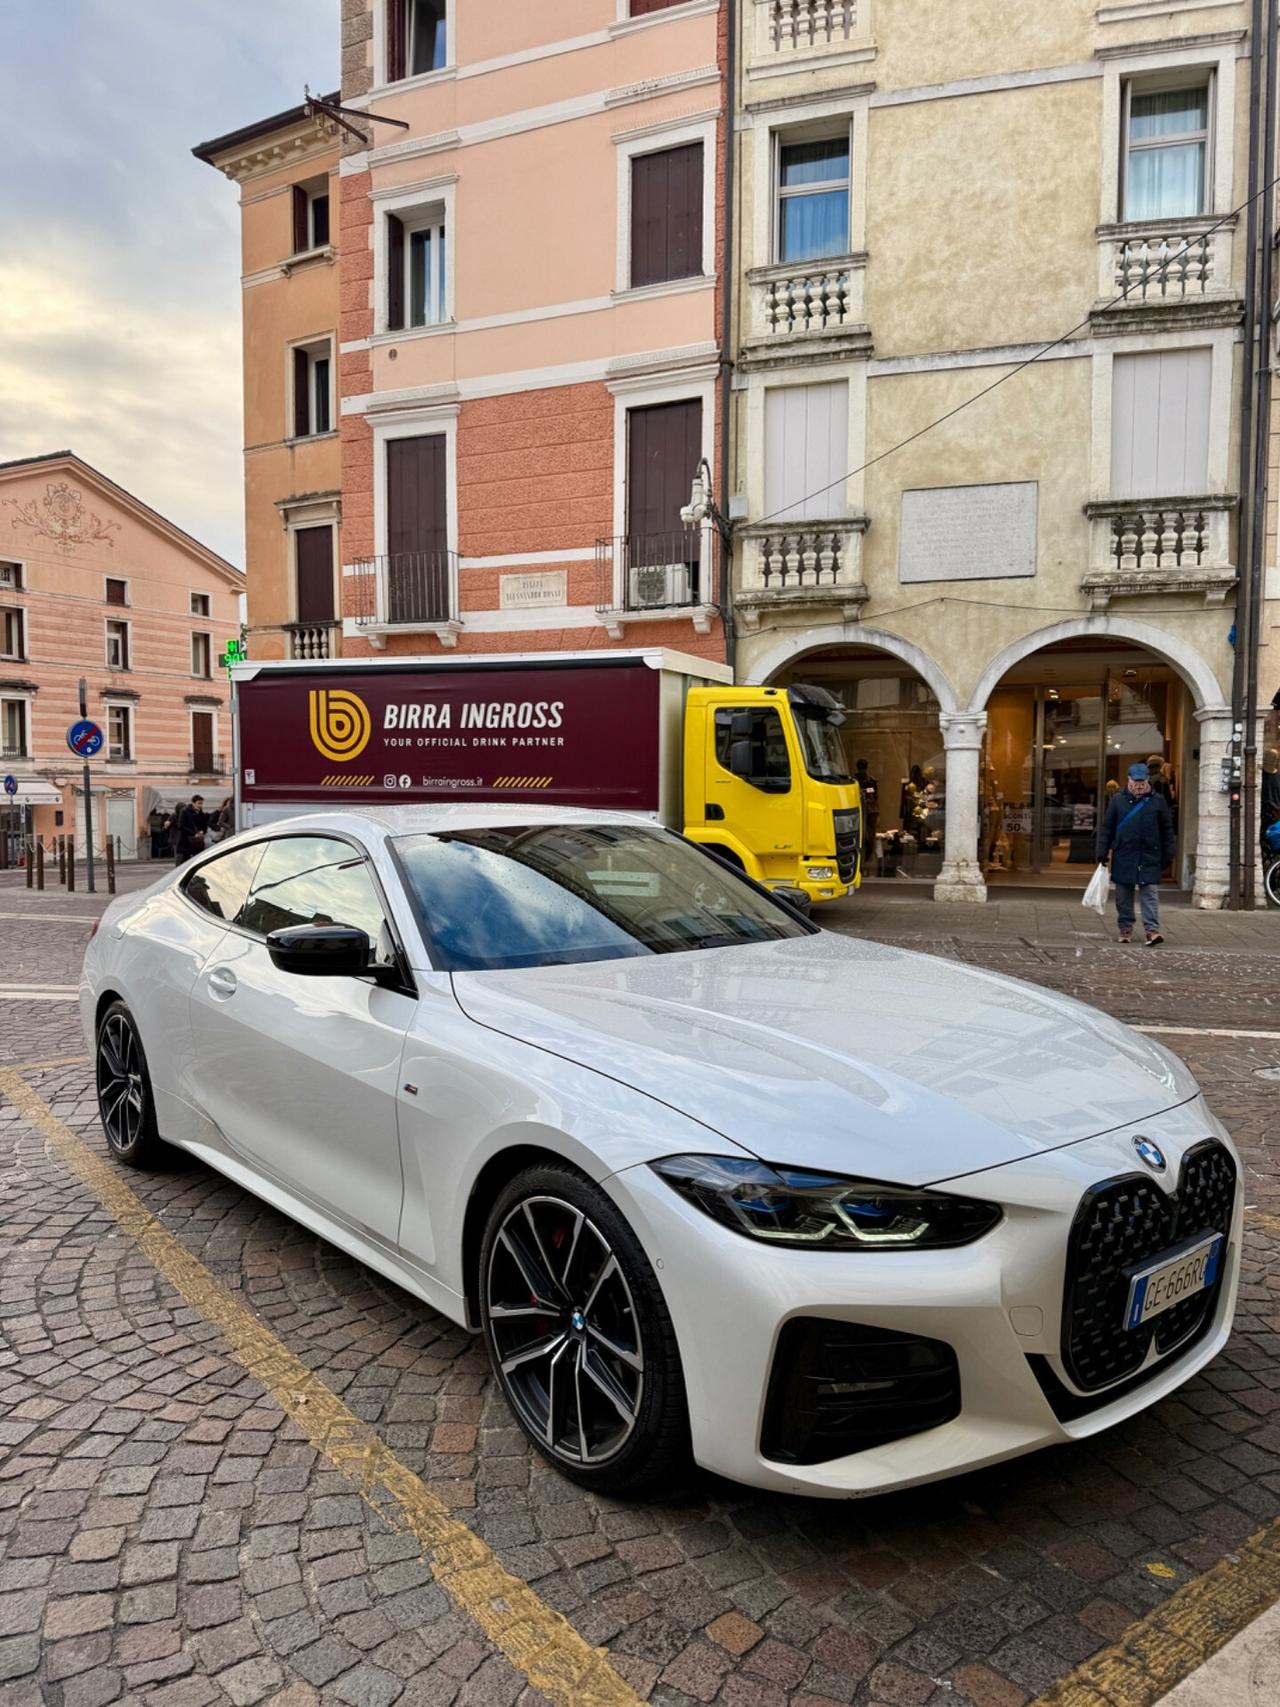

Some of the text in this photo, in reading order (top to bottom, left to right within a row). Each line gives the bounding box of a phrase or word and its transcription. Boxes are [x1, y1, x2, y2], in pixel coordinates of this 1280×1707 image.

[383, 701, 564, 729] BIRRA INGROSS
[383, 737, 564, 747] YOUR OFFICIAL DRINK PARTNER
[422, 775, 483, 789] birraingross.it
